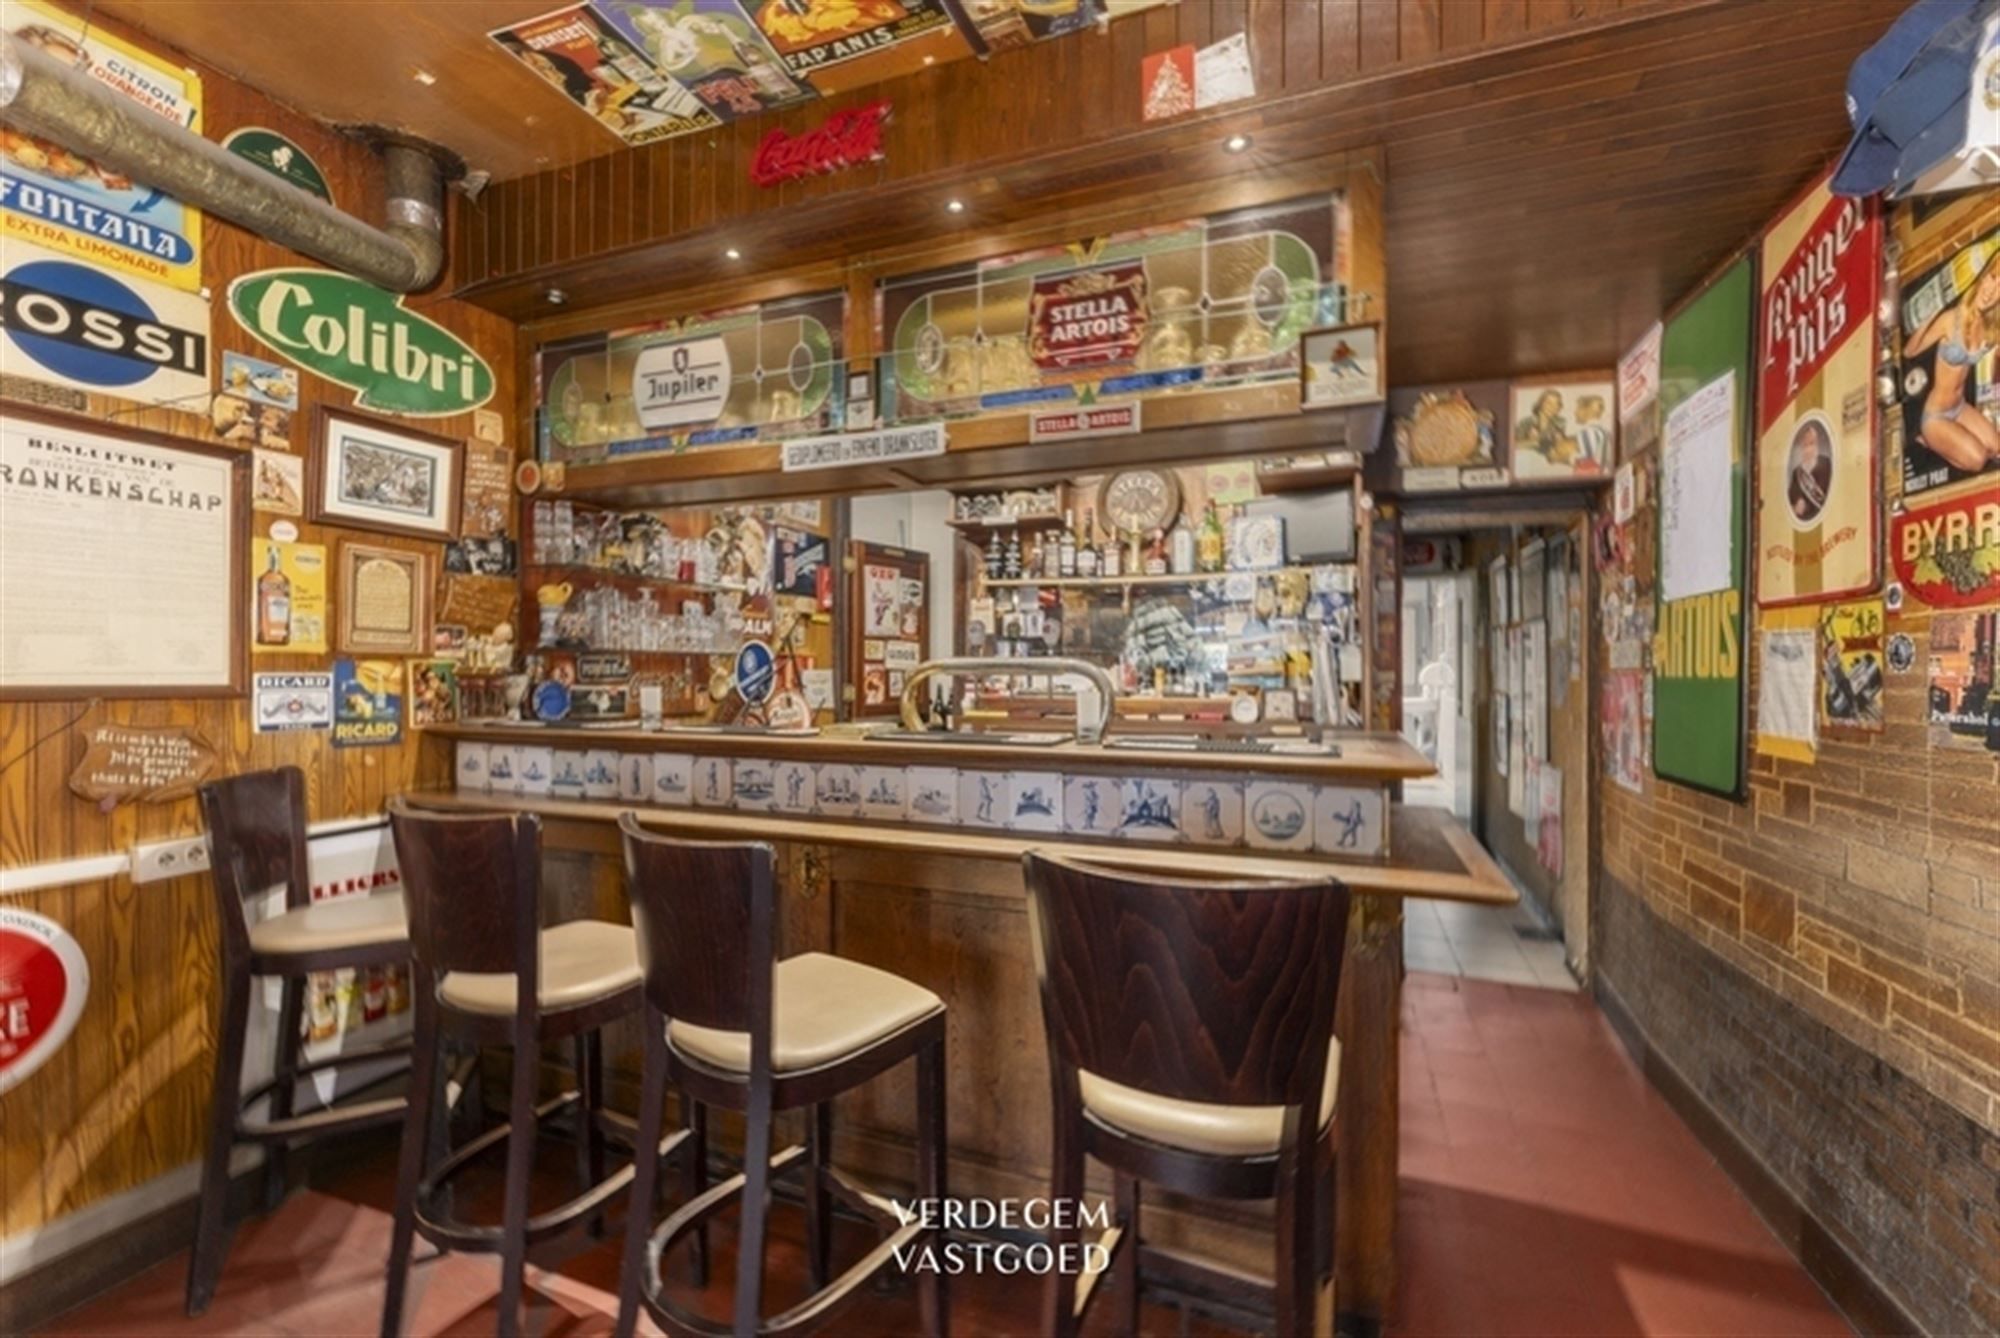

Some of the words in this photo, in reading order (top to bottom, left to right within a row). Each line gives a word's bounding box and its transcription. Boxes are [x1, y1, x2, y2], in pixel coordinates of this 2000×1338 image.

[784, 26, 894, 70] FAP'ANIS
[94, 65, 184, 124] ORANGEADE
[106, 58, 179, 107] CITRON
[0, 179, 178, 259] FONTANA
[6, 214, 69, 246] EXTRA
[75, 235, 169, 278] LIMONADE
[0, 288, 195, 370] OSSI
[1051, 295, 1129, 323] STELLA
[1051, 314, 1131, 342] ARTOIS
[258, 279, 474, 400] Colibri
[647, 372, 719, 401] Jupiler
[1038, 416, 1075, 432] STELLA
[1091, 410, 1131, 426] ARTOIS
[28, 437, 175, 472] BESLUITWET
[1902, 502, 2000, 563] BYRR
[1653, 589, 1739, 678] ARTOIS
[260, 676, 328, 688] RICARD
[336, 723, 398, 740] RICARD
